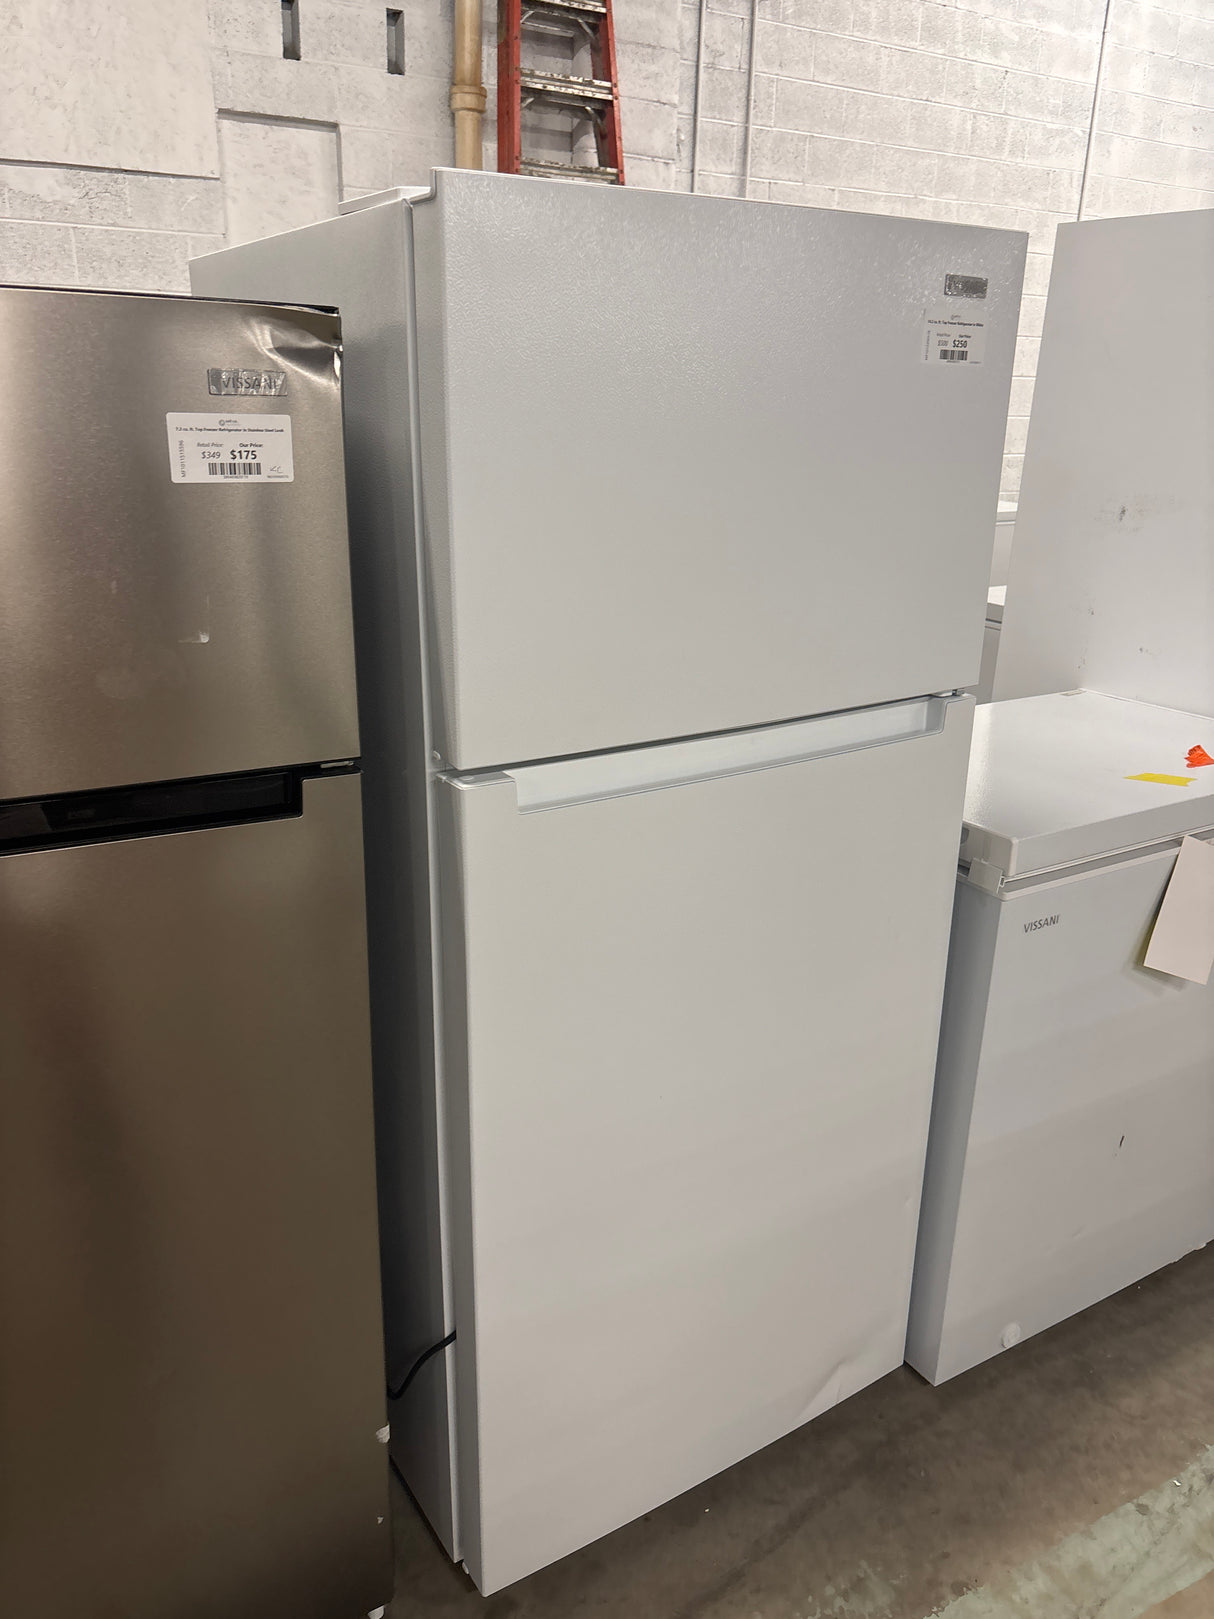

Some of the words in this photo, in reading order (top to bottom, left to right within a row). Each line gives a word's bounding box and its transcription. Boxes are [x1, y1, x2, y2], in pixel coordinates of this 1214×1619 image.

[952, 339, 968, 348] $250
[222, 376, 277, 390] VISSANI
[201, 451, 220, 459] $349
[230, 450, 257, 460] $175
[1024, 914, 1060, 933] VISSANI
